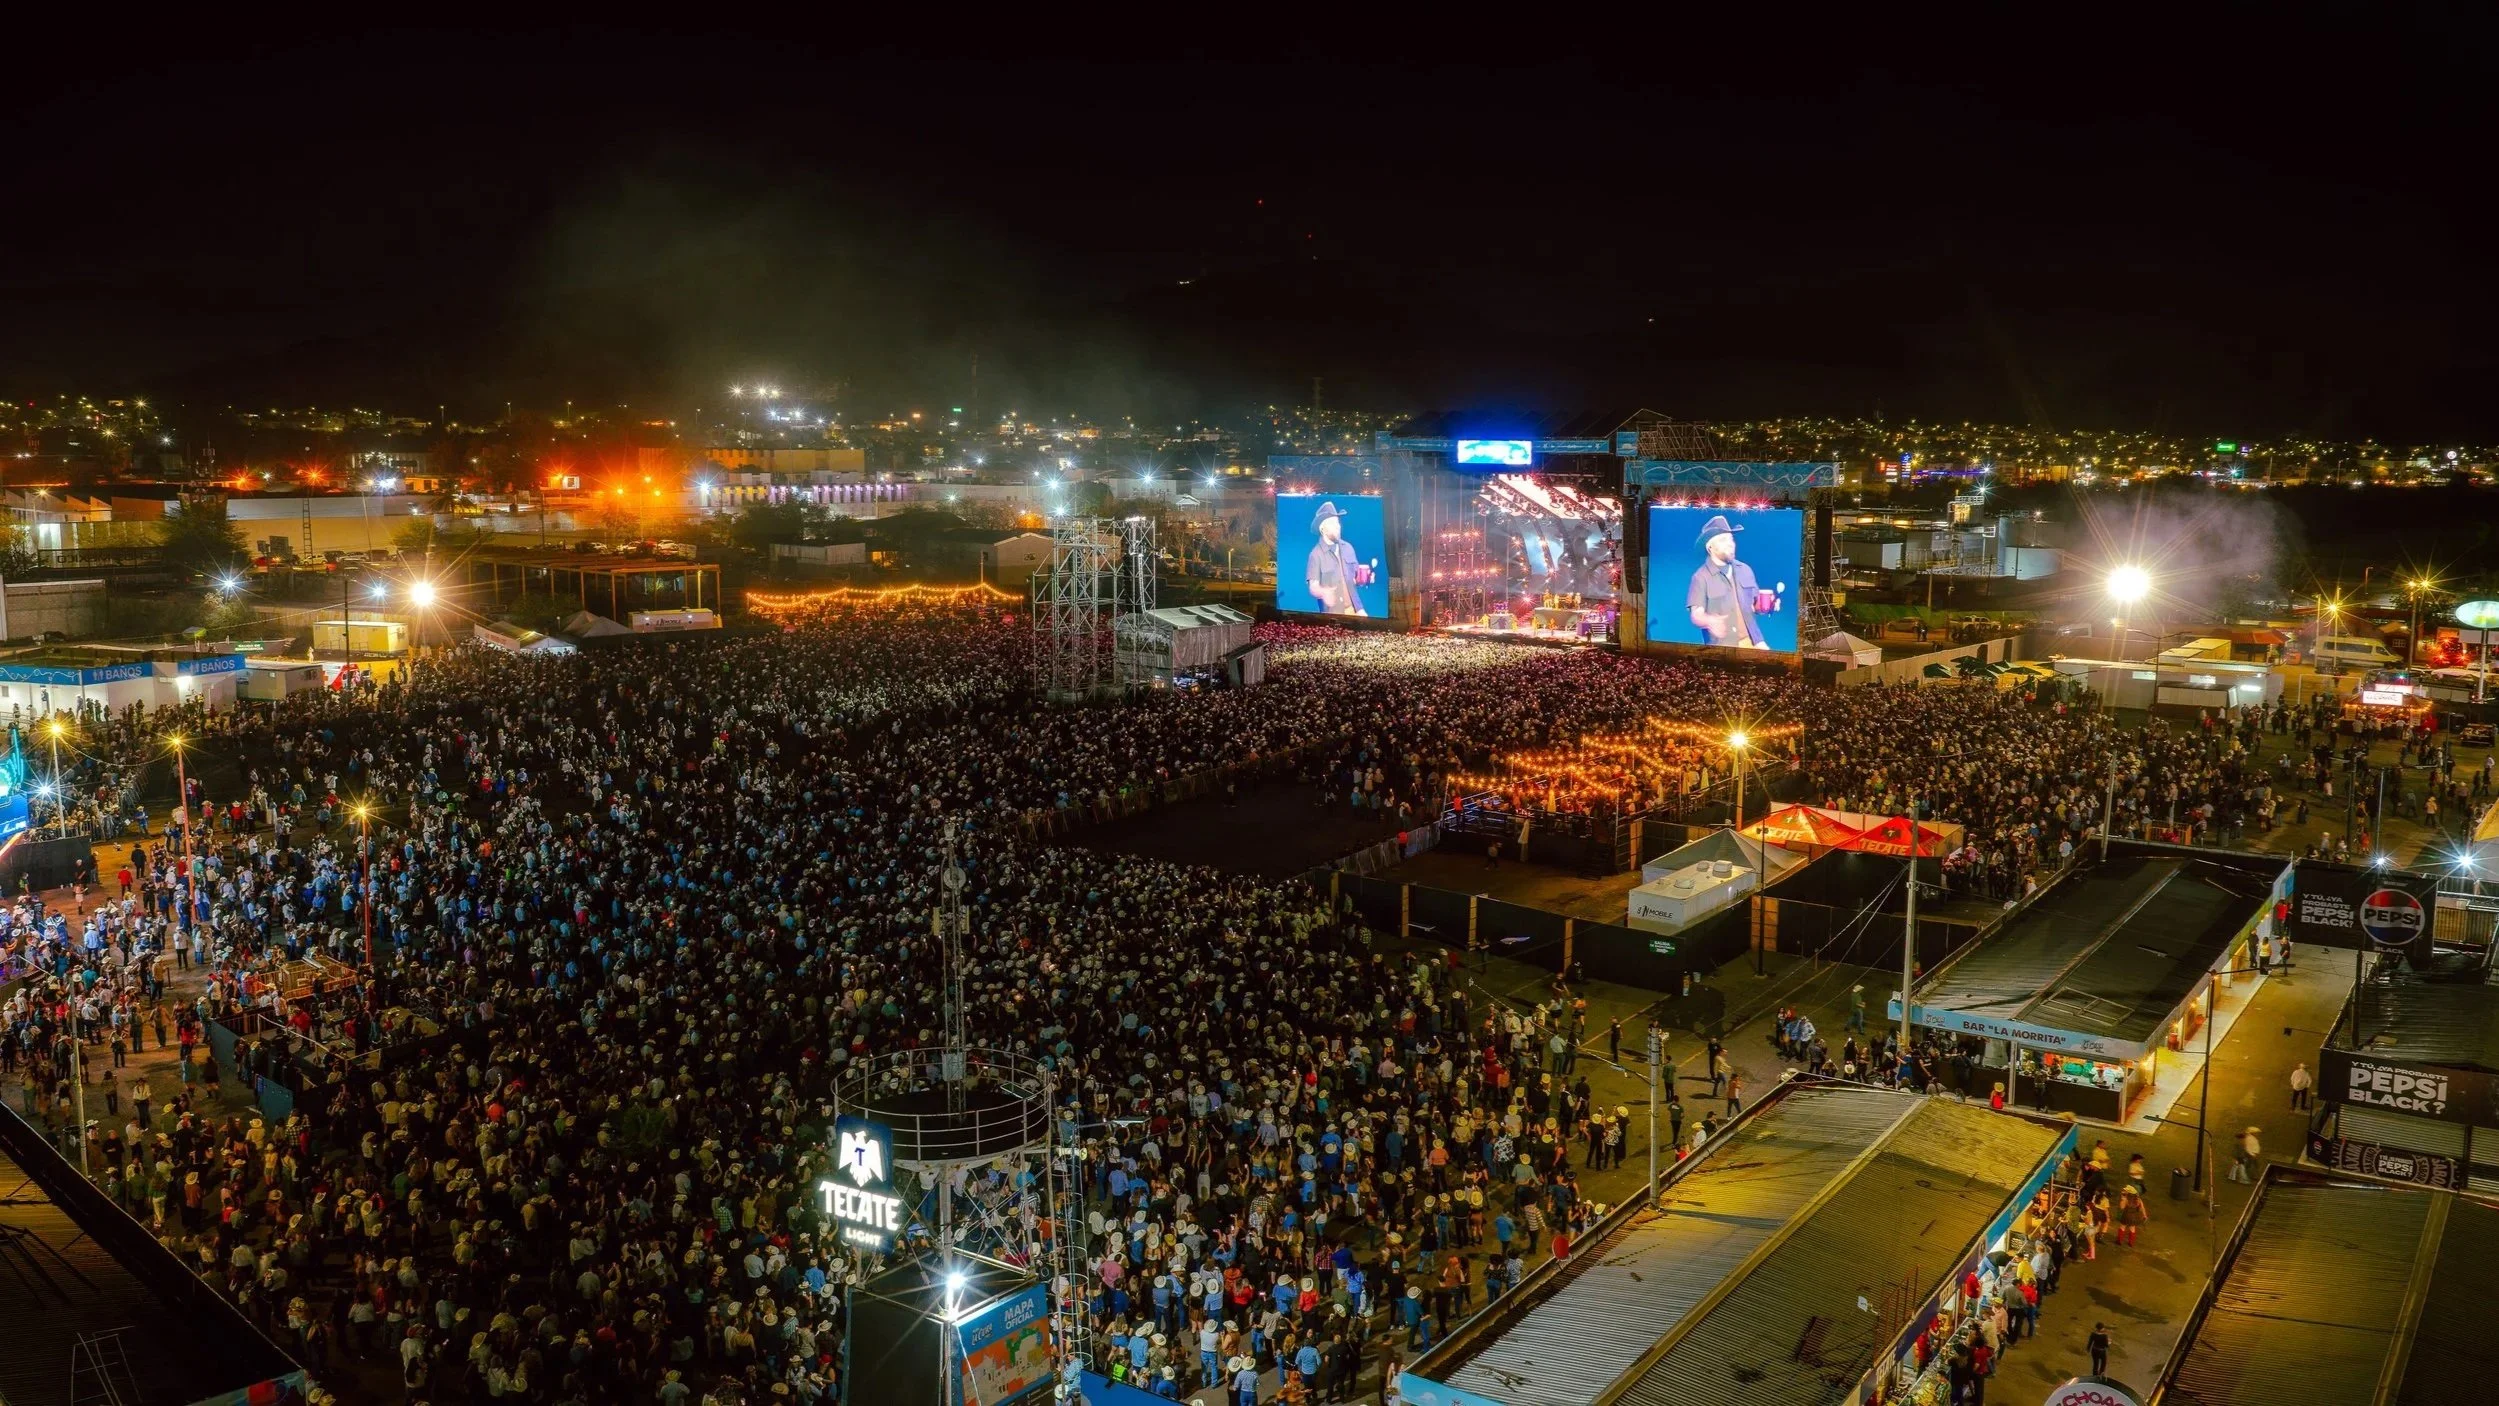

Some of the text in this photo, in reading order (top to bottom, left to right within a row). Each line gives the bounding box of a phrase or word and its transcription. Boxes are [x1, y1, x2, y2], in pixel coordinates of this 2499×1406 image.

[105, 666, 142, 680] BAÑOS
[200, 659, 236, 673] BAÑOS
[1859, 838, 1908, 855] TECATE
[2302, 900, 2351, 910] PROBASTE
[2302, 905, 2354, 920] PEPSI
[2301, 915, 2353, 929] BLACK?
[2364, 908, 2420, 926] PEPSI
[2374, 946, 2404, 954] BLACK
[1963, 1021, 2066, 1045] BAR "LA MORRITA"
[2377, 1065, 2394, 1073] ¿YA
[2395, 1068, 2449, 1081] PROBASTE
[2350, 1067, 2448, 1102] PEPSI
[2379, 1159, 2413, 1173] PEPSI
[818, 1180, 902, 1232] TECATE
[845, 1227, 881, 1246] LIGHT
[1004, 1298, 1034, 1322] MAPA
[1005, 1310, 1034, 1330] OFICIAL
